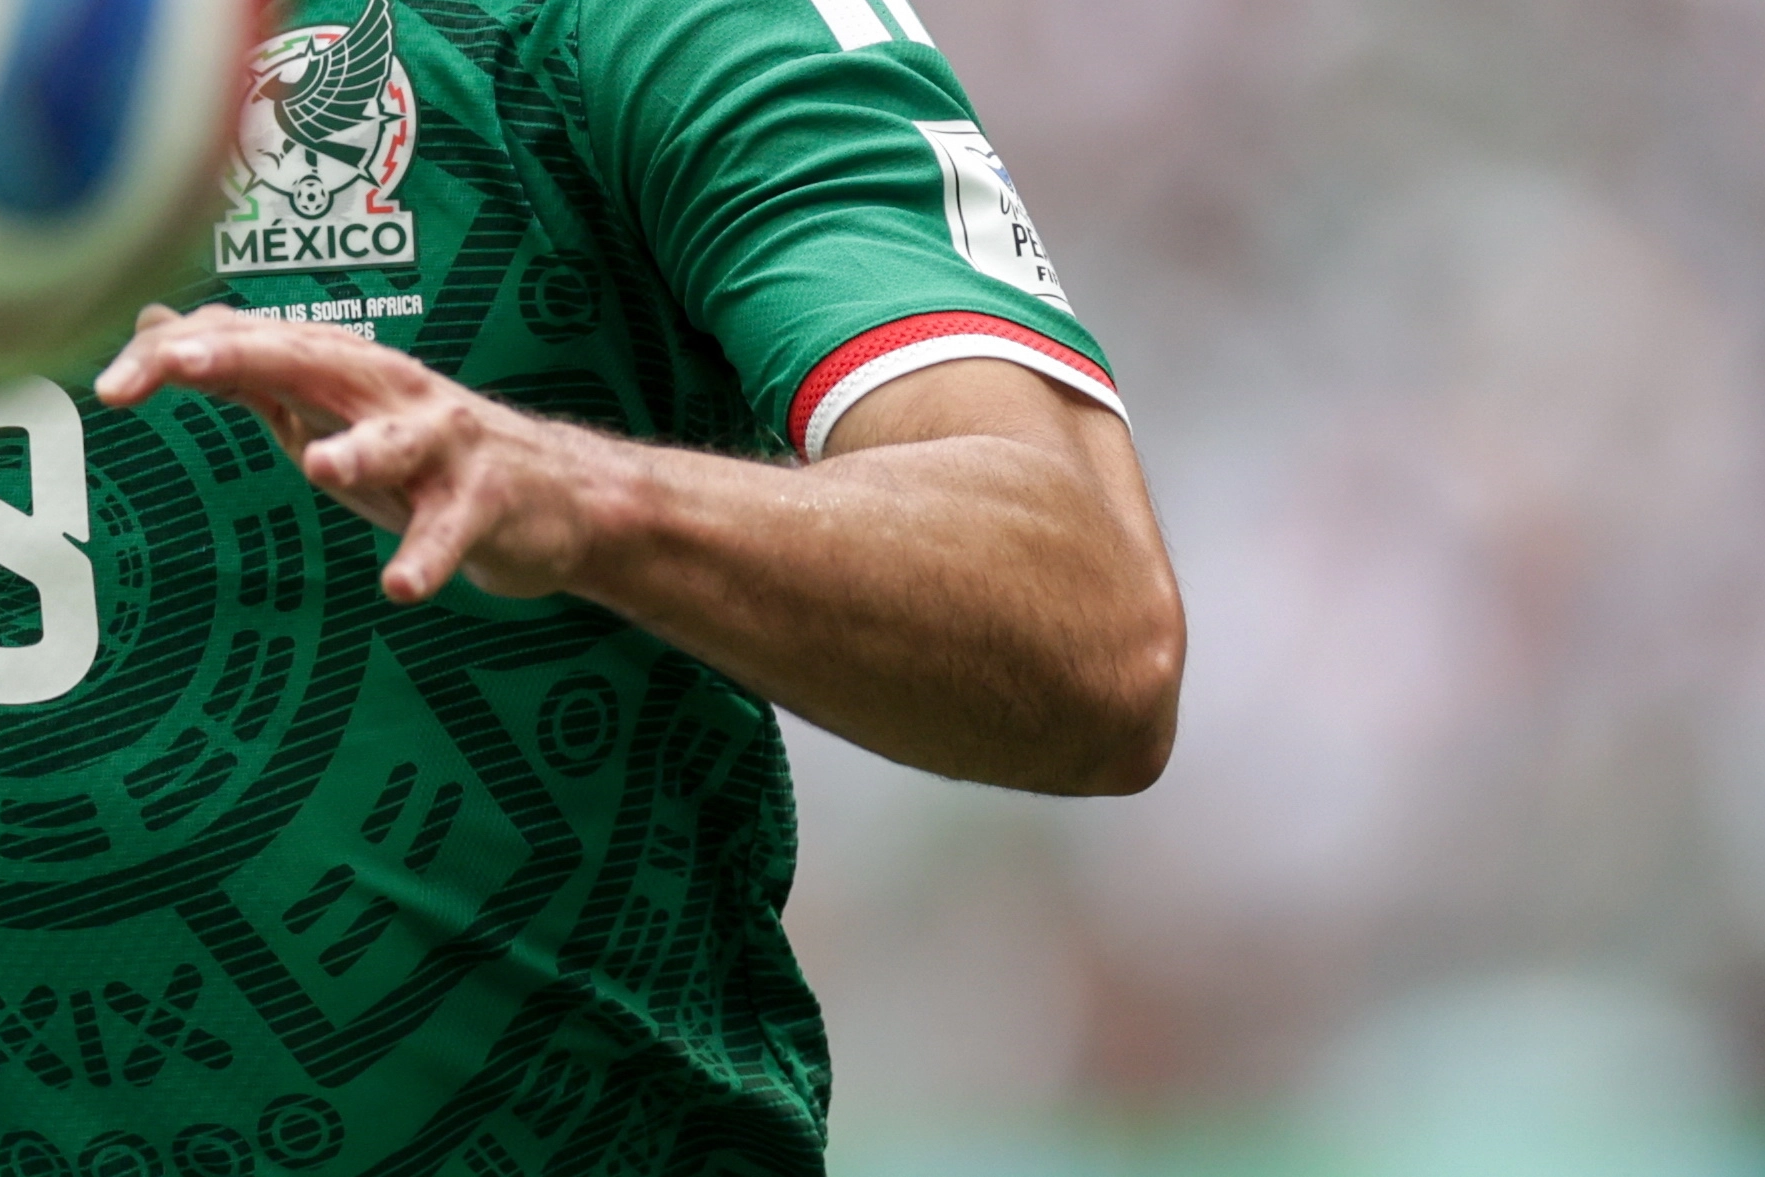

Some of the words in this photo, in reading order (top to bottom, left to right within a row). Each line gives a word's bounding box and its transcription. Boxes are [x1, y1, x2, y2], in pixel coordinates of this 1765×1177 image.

[220, 218, 407, 265] MÉXICO
[311, 299, 362, 322] SOUTH
[366, 294, 423, 318] AFRICA
